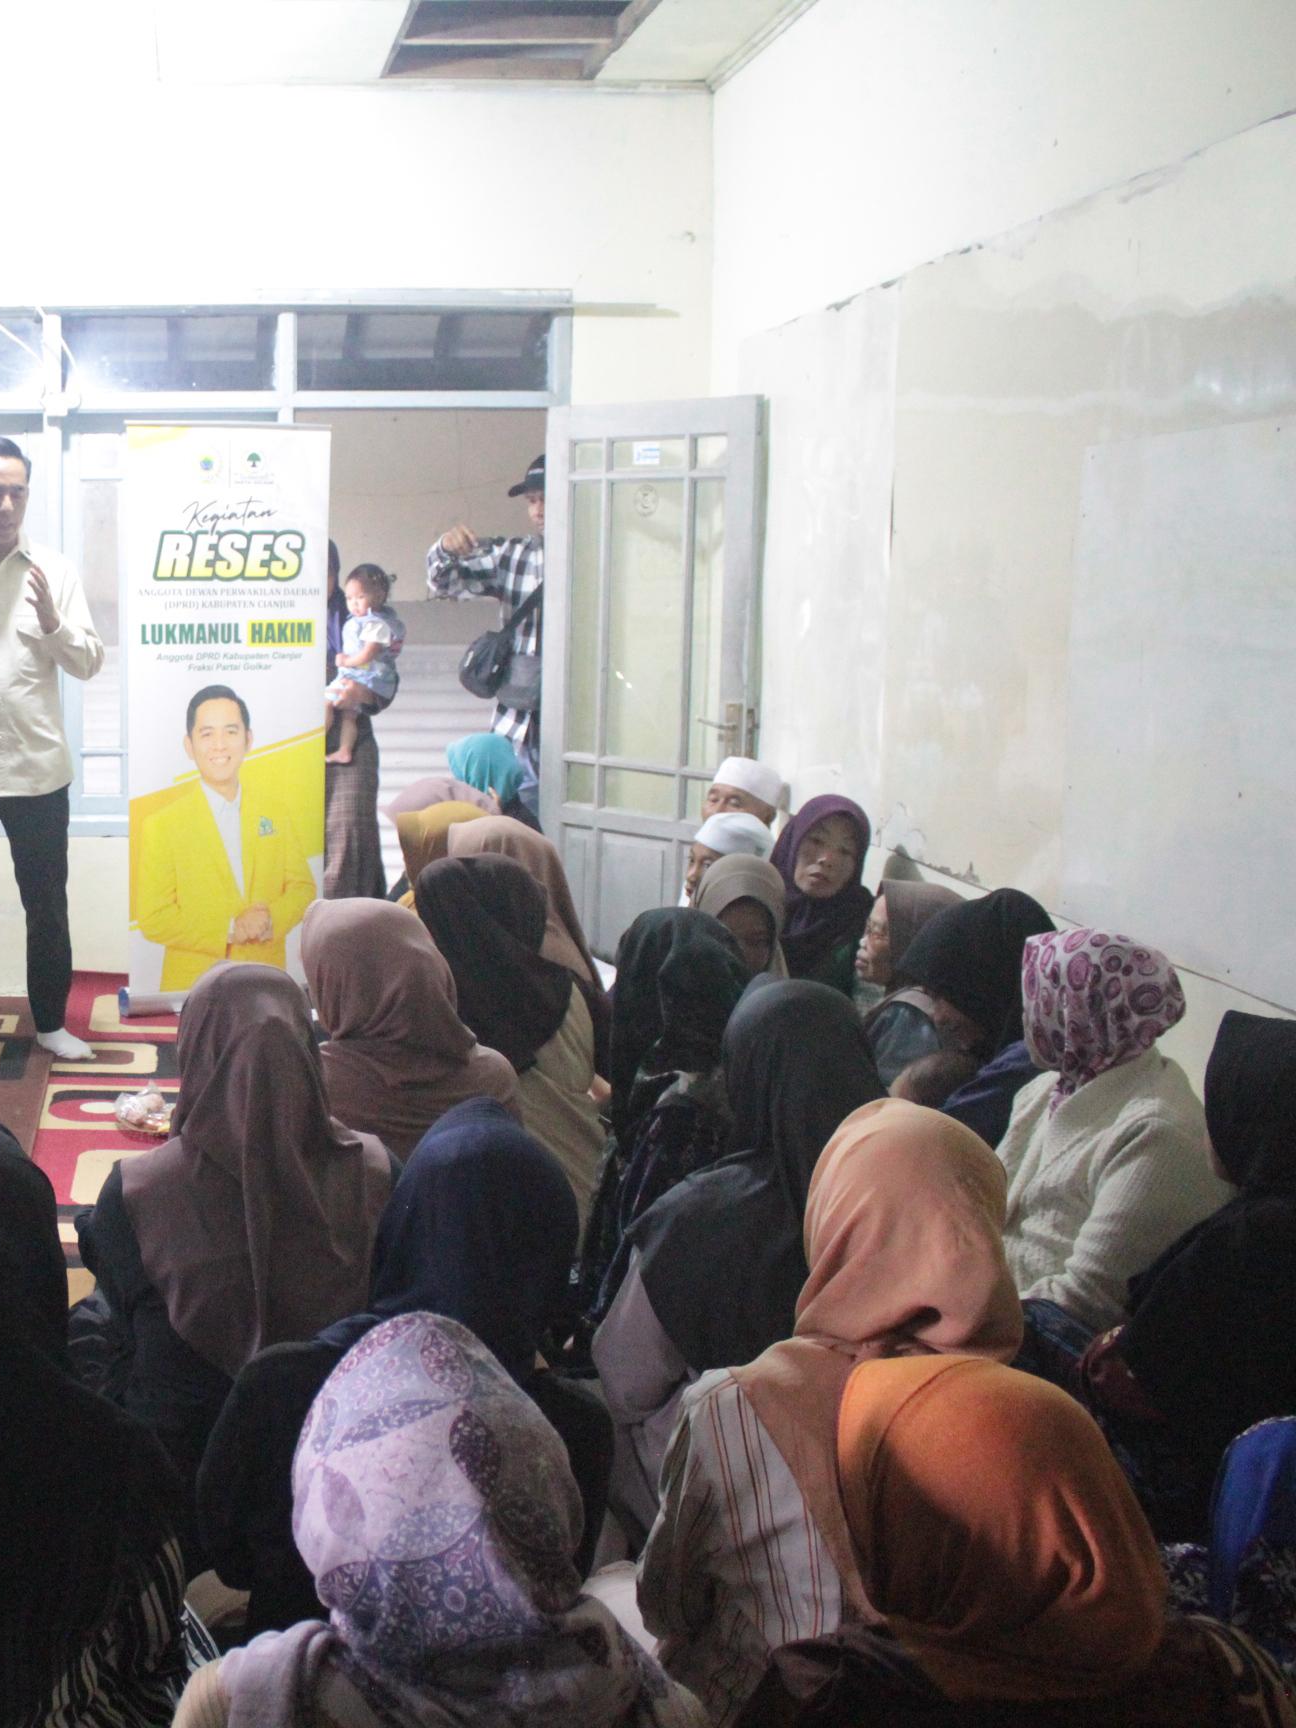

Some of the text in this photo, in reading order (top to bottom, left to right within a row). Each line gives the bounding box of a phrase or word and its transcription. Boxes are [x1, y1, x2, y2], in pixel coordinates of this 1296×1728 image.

[182, 496, 277, 534] Kegiatan
[153, 529, 305, 581] RESES
[138, 588, 320, 597] ANGGOTA DEWAN PERWAKILAN DAERAH
[164, 599, 295, 610] (DPRD) KABUPATEN CIANJUR
[140, 621, 312, 645] LUKMANUL HAKIM
[156, 651, 303, 663] Anggota DPRD Kabupaten Cianjur
[187, 662, 272, 672] Fraksi Partai Golkar
